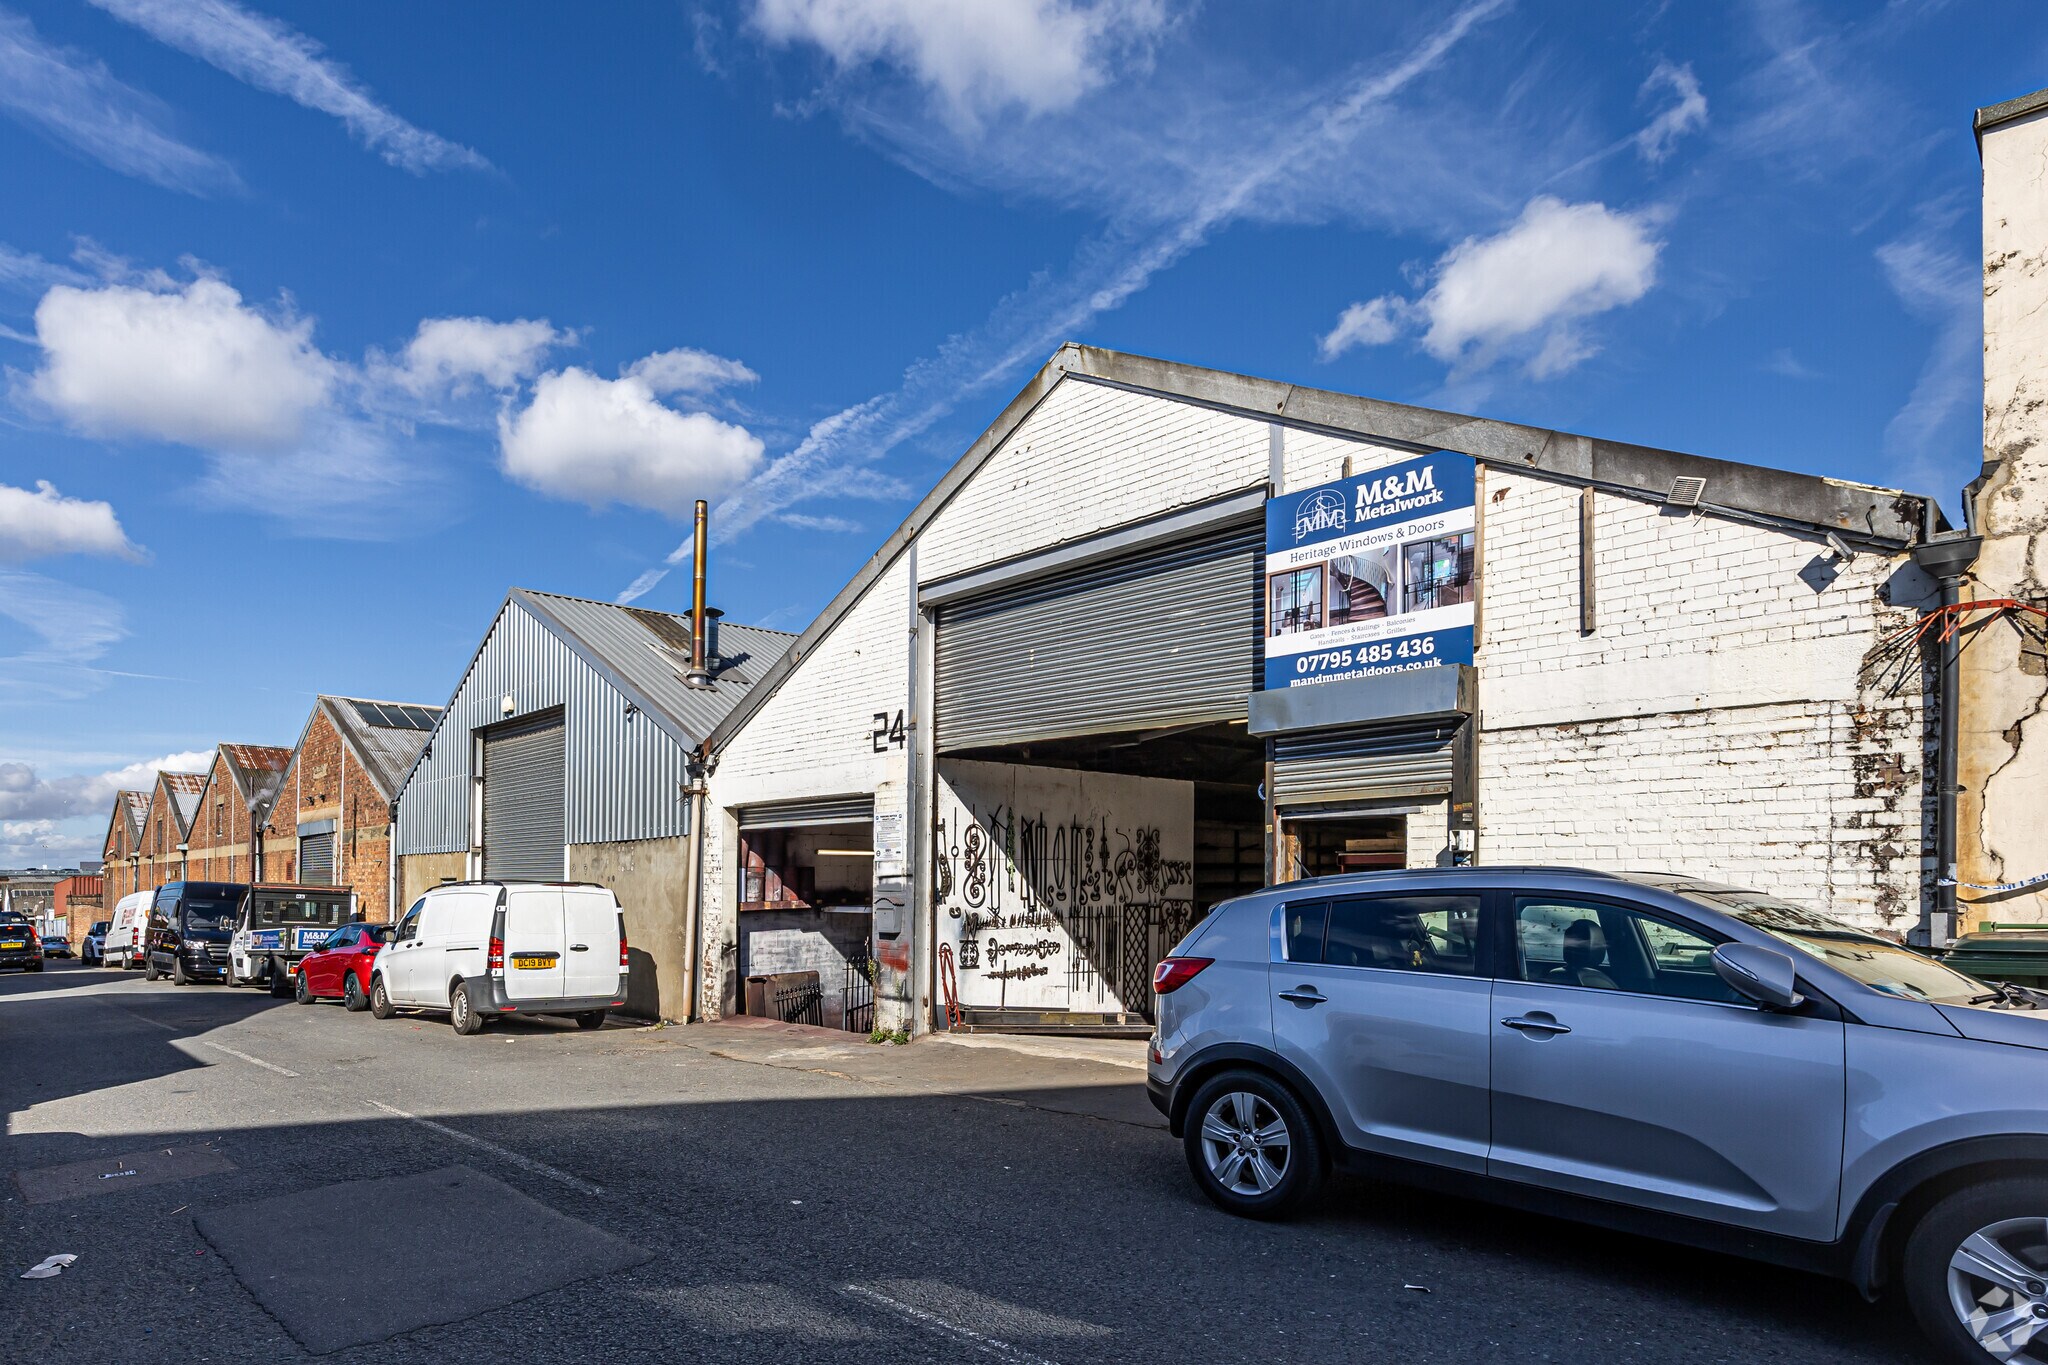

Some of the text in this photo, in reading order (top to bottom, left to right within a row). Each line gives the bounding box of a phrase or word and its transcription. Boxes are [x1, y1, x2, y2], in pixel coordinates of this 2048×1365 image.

[1355, 465, 1435, 508] M&M
[1354, 489, 1443, 523] Metalwork
[1290, 519, 1445, 563] Heritage Windows & Doors
[1309, 632, 1325, 640] Gates
[1331, 628, 1350, 637] Fences
[1356, 623, 1380, 632] Railings
[1386, 616, 1416, 627] Balconies
[1318, 636, 1345, 646] Handrails
[1351, 630, 1381, 641] Staircases
[1386, 625, 1407, 635] Grilles
[1296, 636, 1435, 673] 07795 485 436
[1290, 656, 1442, 688] mandmmetaldoors.co.uk
[873, 709, 906, 753] 24
[303, 931, 329, 940] M&M
[518, 958, 552, 967] DC19 BVY
